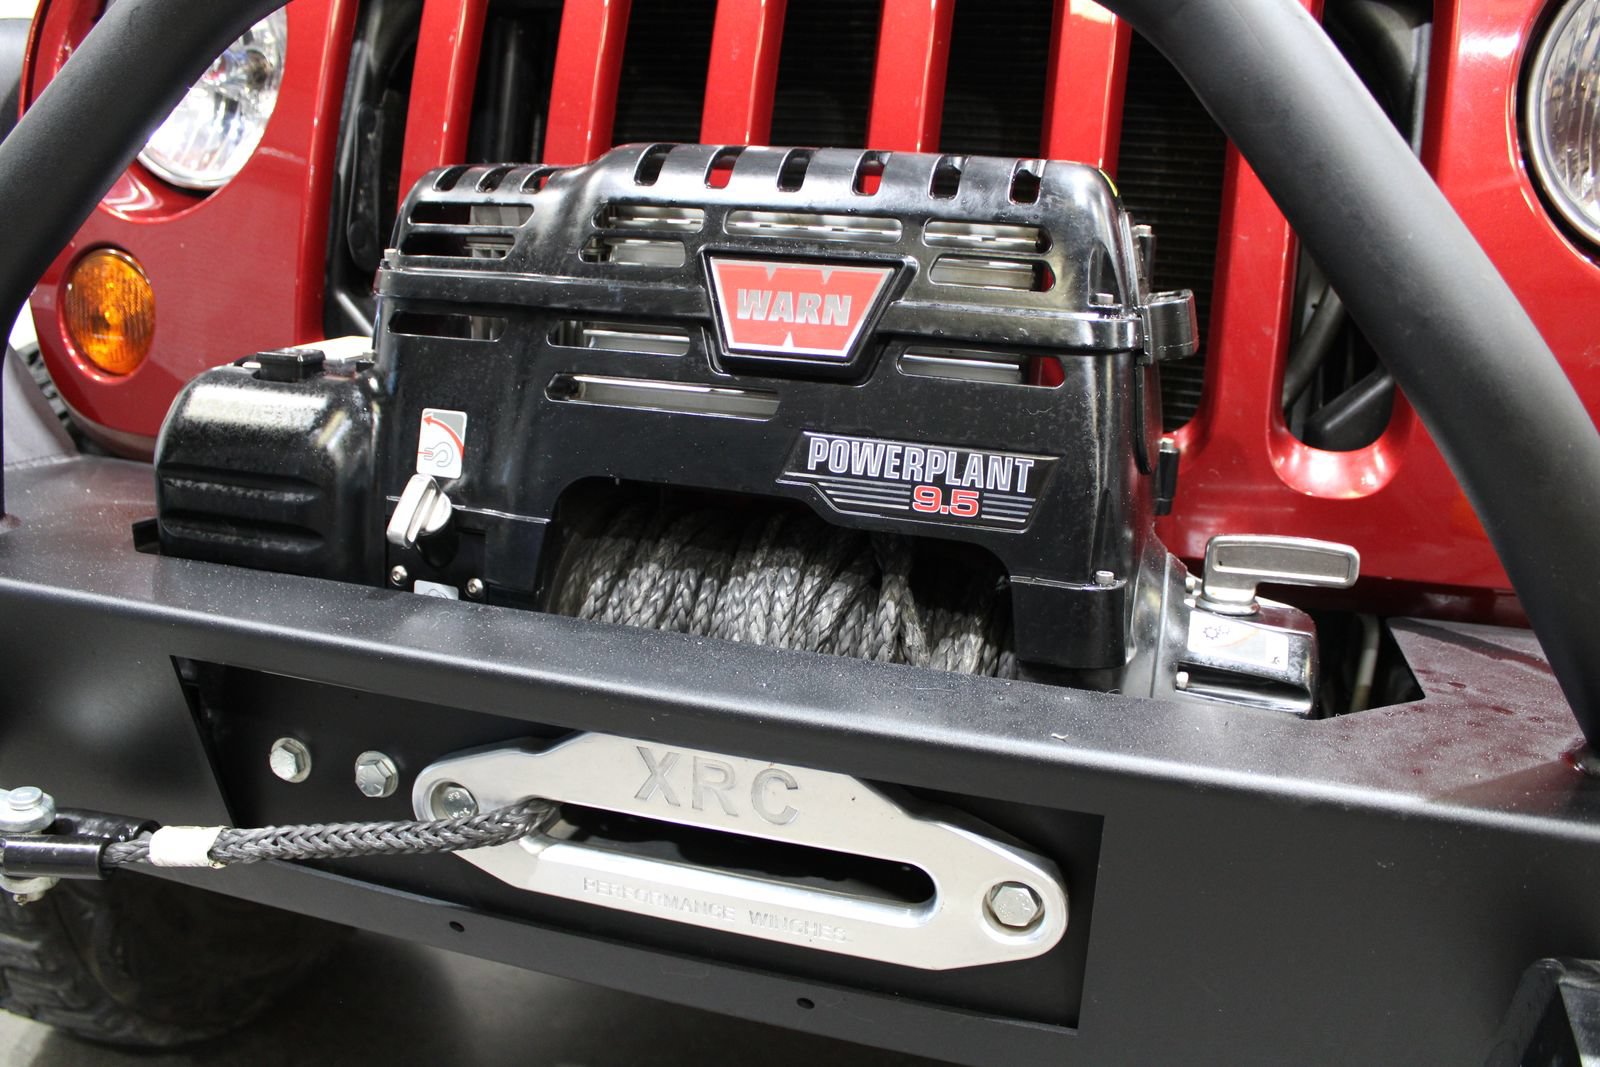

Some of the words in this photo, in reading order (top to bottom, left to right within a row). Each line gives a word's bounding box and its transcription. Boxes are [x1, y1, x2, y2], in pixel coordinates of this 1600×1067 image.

[737, 288, 852, 326] WARN
[807, 437, 1034, 493] POWERPLANT
[912, 485, 979, 518] 9.5
[634, 746, 799, 825] XRC
[583, 877, 736, 921] PERFORMANCE
[748, 910, 847, 943] WINCHES
